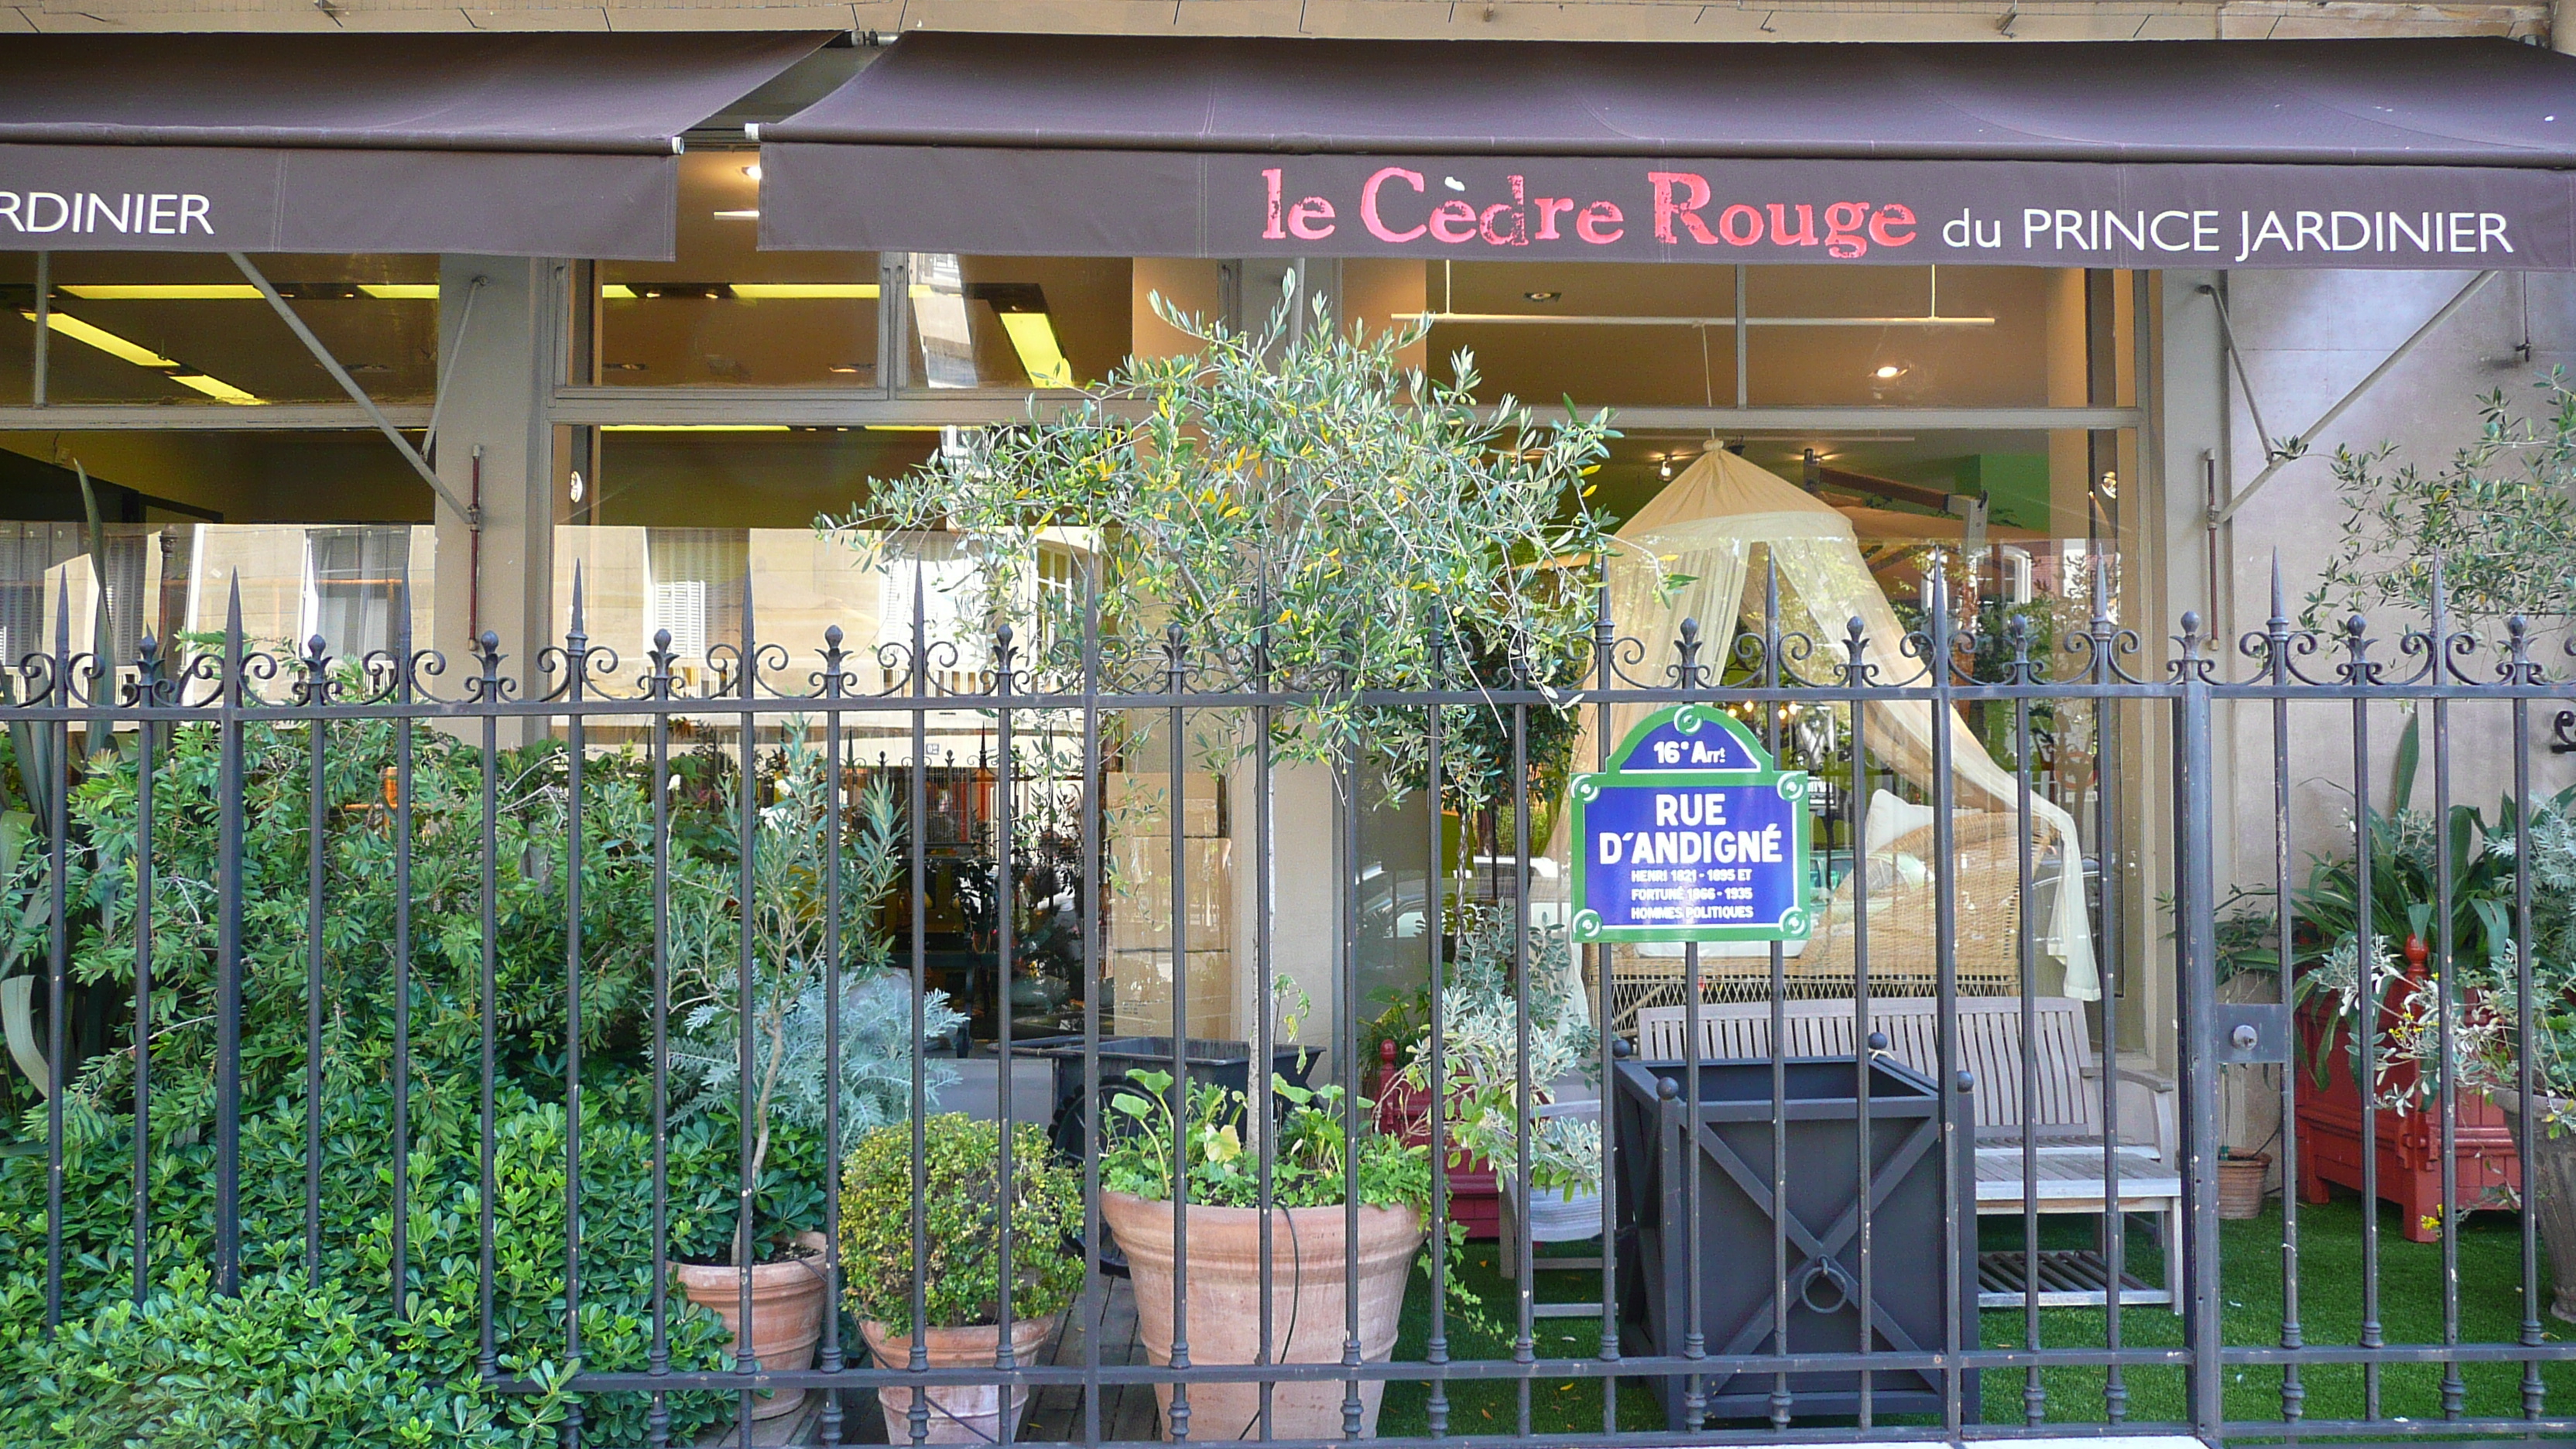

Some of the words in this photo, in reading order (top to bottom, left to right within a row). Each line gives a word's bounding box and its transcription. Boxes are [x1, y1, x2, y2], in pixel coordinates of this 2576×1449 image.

[1262, 168, 1337, 241] le
[1360, 166, 1625, 247] Cèdre
[1647, 171, 1918, 259] Rouge
[1942, 207, 2002, 248] du
[2023, 208, 2220, 252] PRINCE
[2235, 211, 2515, 262] JARDINIER
[1656, 793, 1727, 827] RUE
[1599, 823, 1783, 865] D'ANDIGNÉ
[1631, 869, 1668, 882] HENRI
[1670, 868, 1697, 882] 1821
[1706, 868, 1736, 882] 1895
[1737, 868, 1753, 882] ET
[1631, 886, 1684, 901] FORTUNÉ
[1687, 887, 1716, 900] 1866
[1724, 887, 1753, 899] 1935
[1631, 906, 1683, 920] HOMMES
[1684, 906, 1755, 920] POLITIQUES
